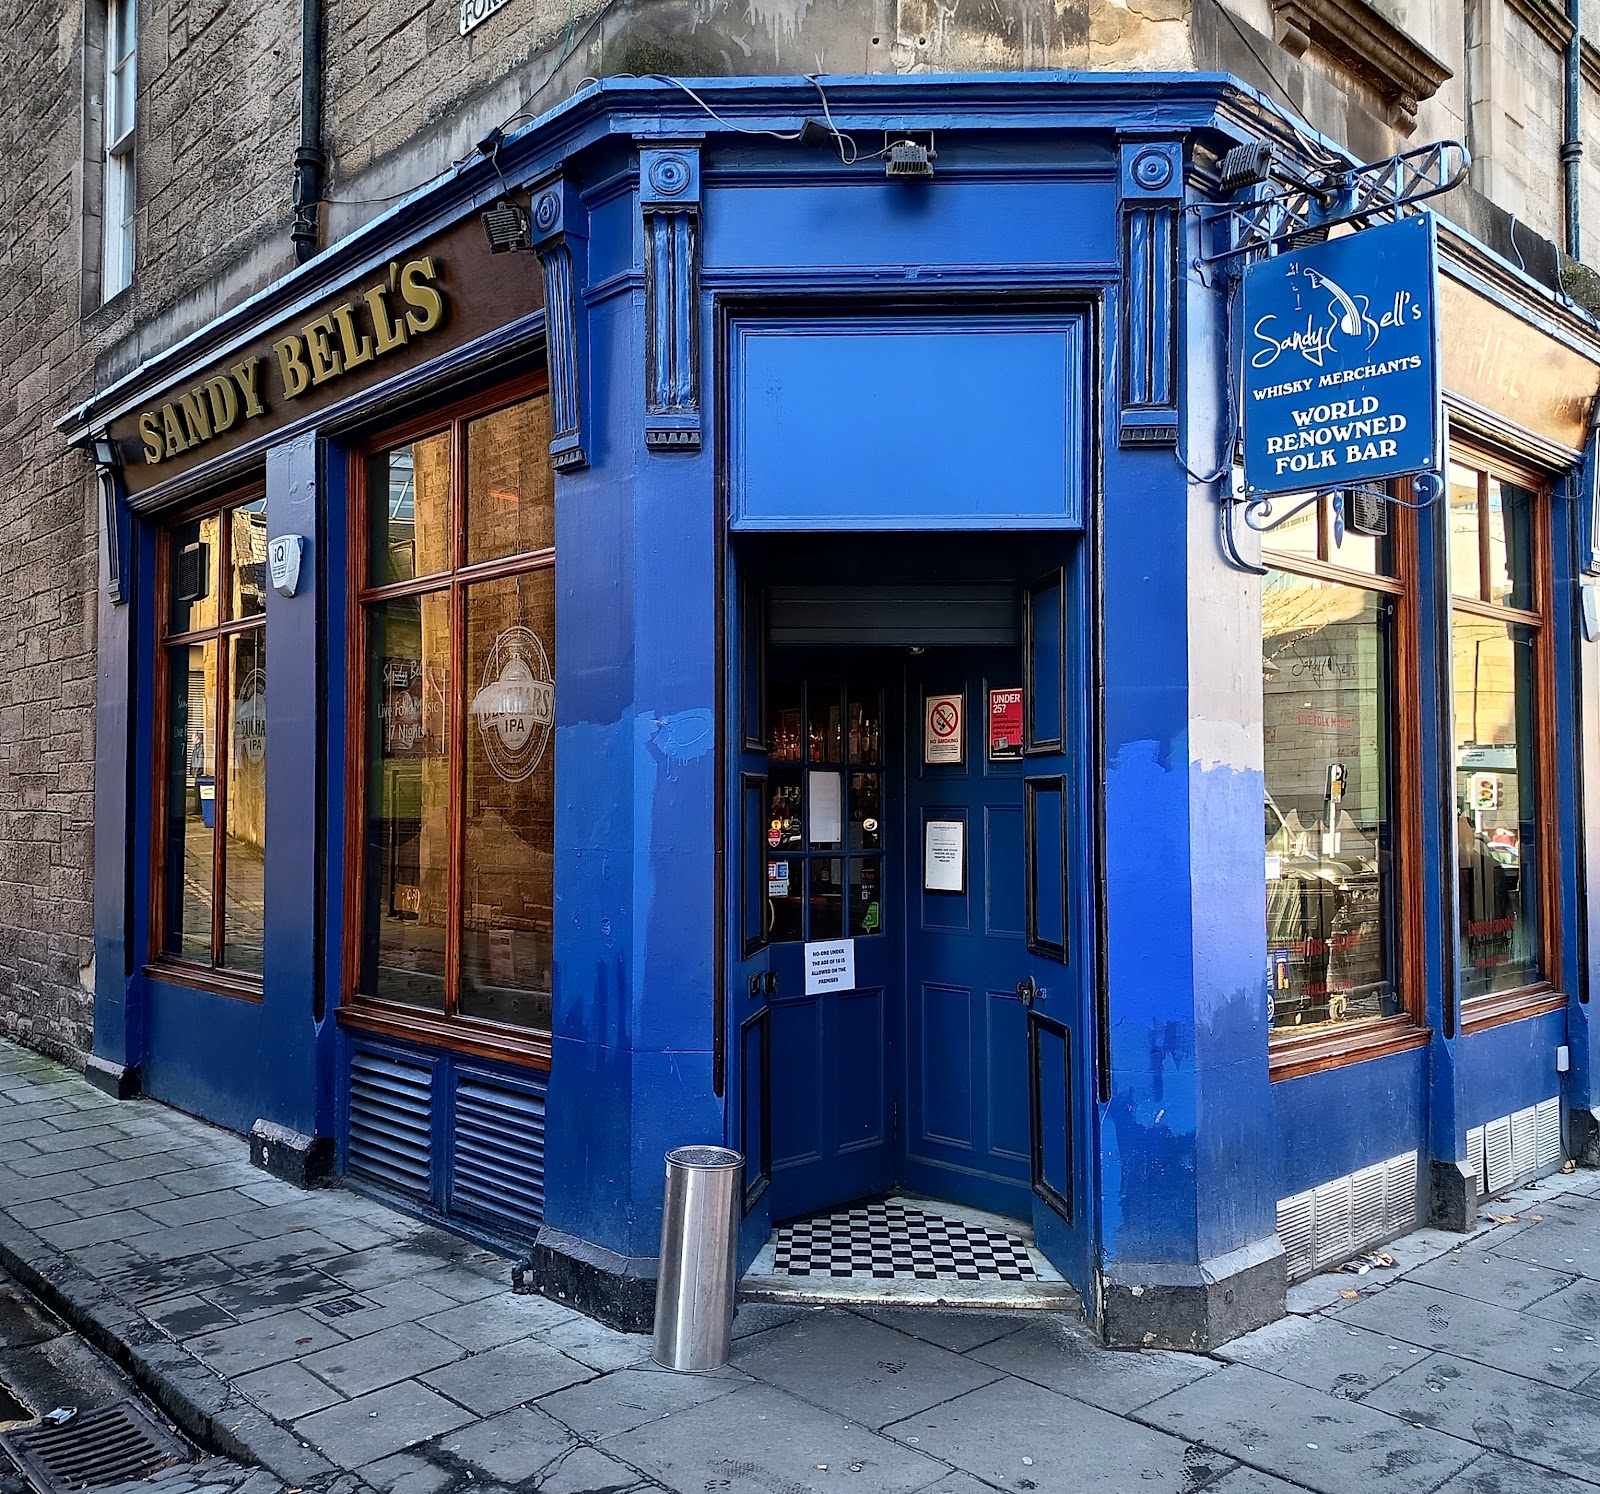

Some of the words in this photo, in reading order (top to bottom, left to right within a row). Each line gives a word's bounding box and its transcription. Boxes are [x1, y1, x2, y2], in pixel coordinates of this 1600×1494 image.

[1251, 314, 1328, 368] Sandy
[138, 355, 264, 465] SANDY
[273, 256, 442, 400] BELL'S
[1253, 378, 1313, 401] WHISKY
[1318, 355, 1422, 388] MERCHANTS
[1291, 396, 1379, 427] WORLD
[1267, 414, 1407, 454] RENOWNED
[1276, 449, 1337, 475] FOLK
[1346, 439, 1398, 464] BAR
[992, 704, 1007, 714] 25?
[993, 694, 1021, 704] UNDER
[505, 718, 525, 734] IPA
[1314, 715, 1330, 727] FOLK
[1331, 716, 1351, 728] MUSIC
[249, 739, 262, 751] IPA
